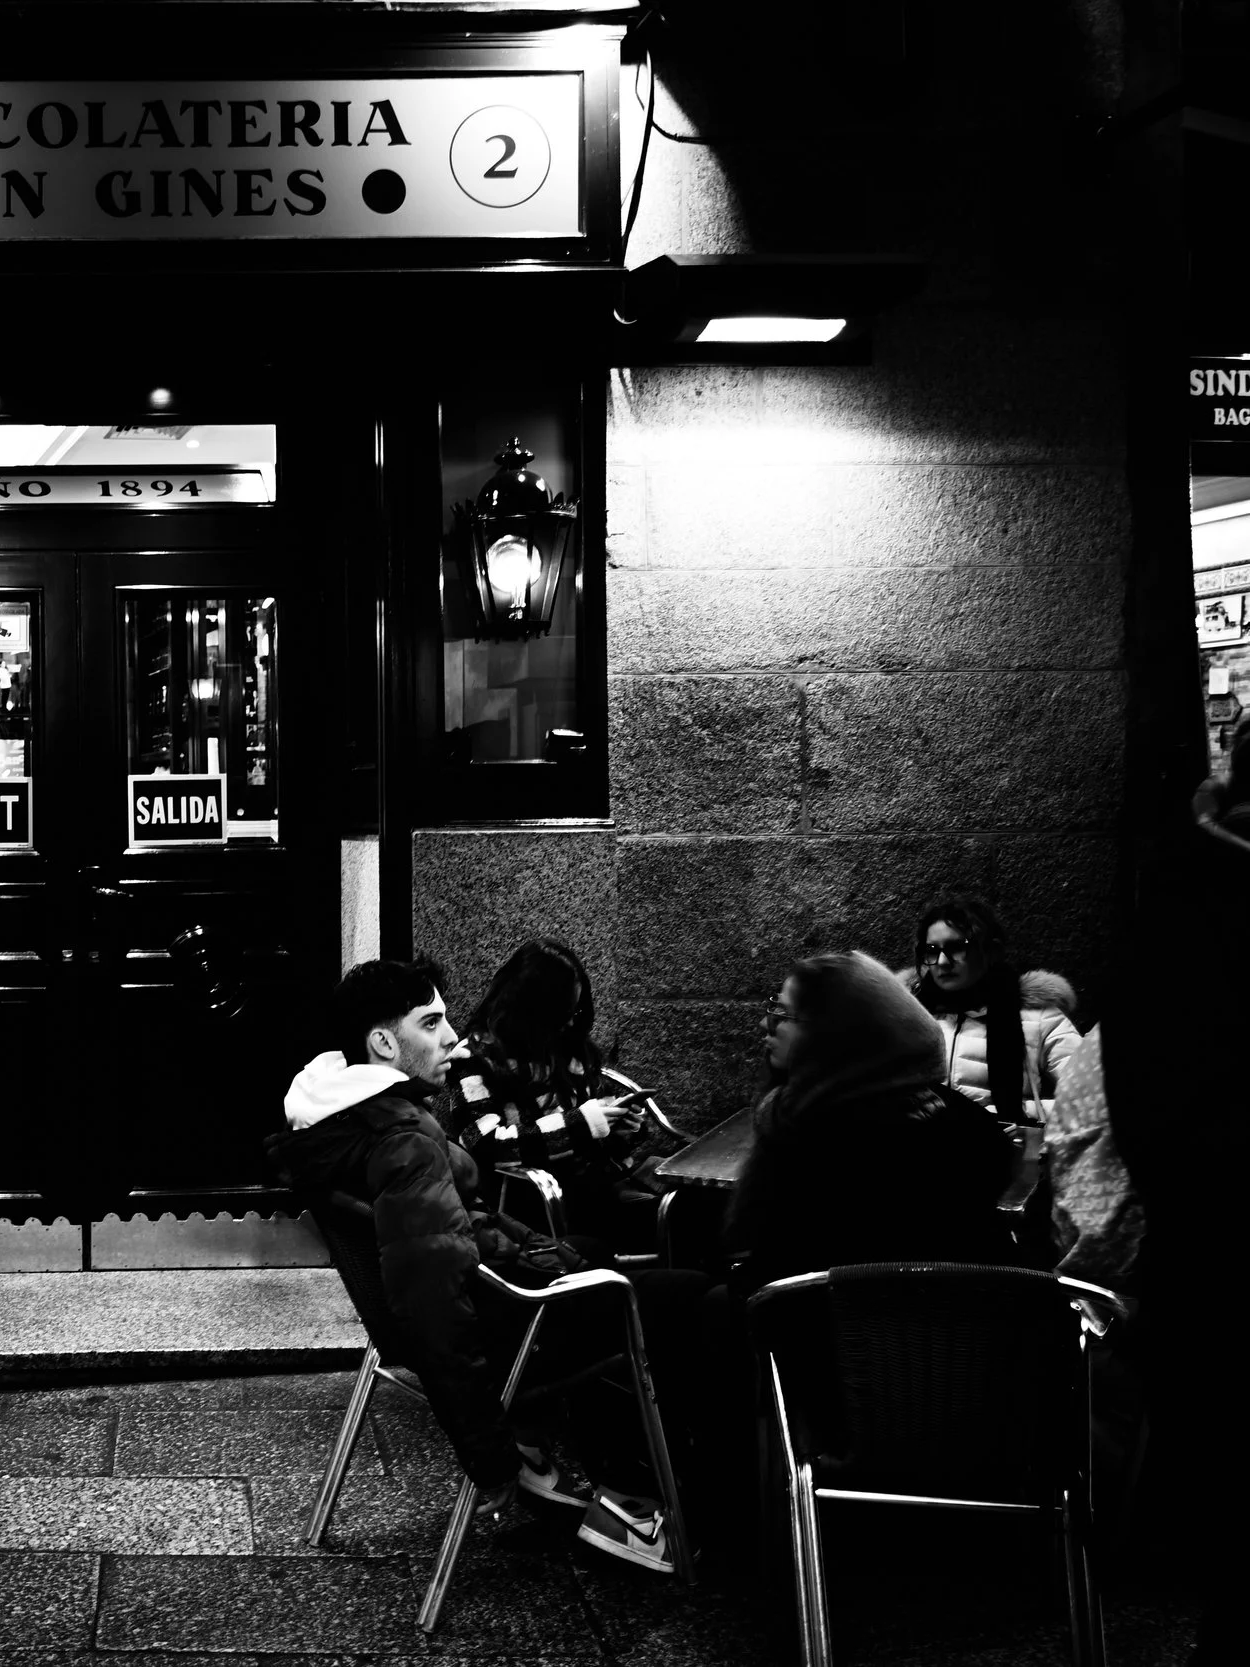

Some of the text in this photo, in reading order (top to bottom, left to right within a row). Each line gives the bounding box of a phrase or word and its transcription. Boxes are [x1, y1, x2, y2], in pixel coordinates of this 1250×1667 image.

[483, 134, 519, 179] 2
[96, 167, 328, 217] GINES
[97, 479, 202, 497] 1894
[136, 795, 219, 825] SALIDA
